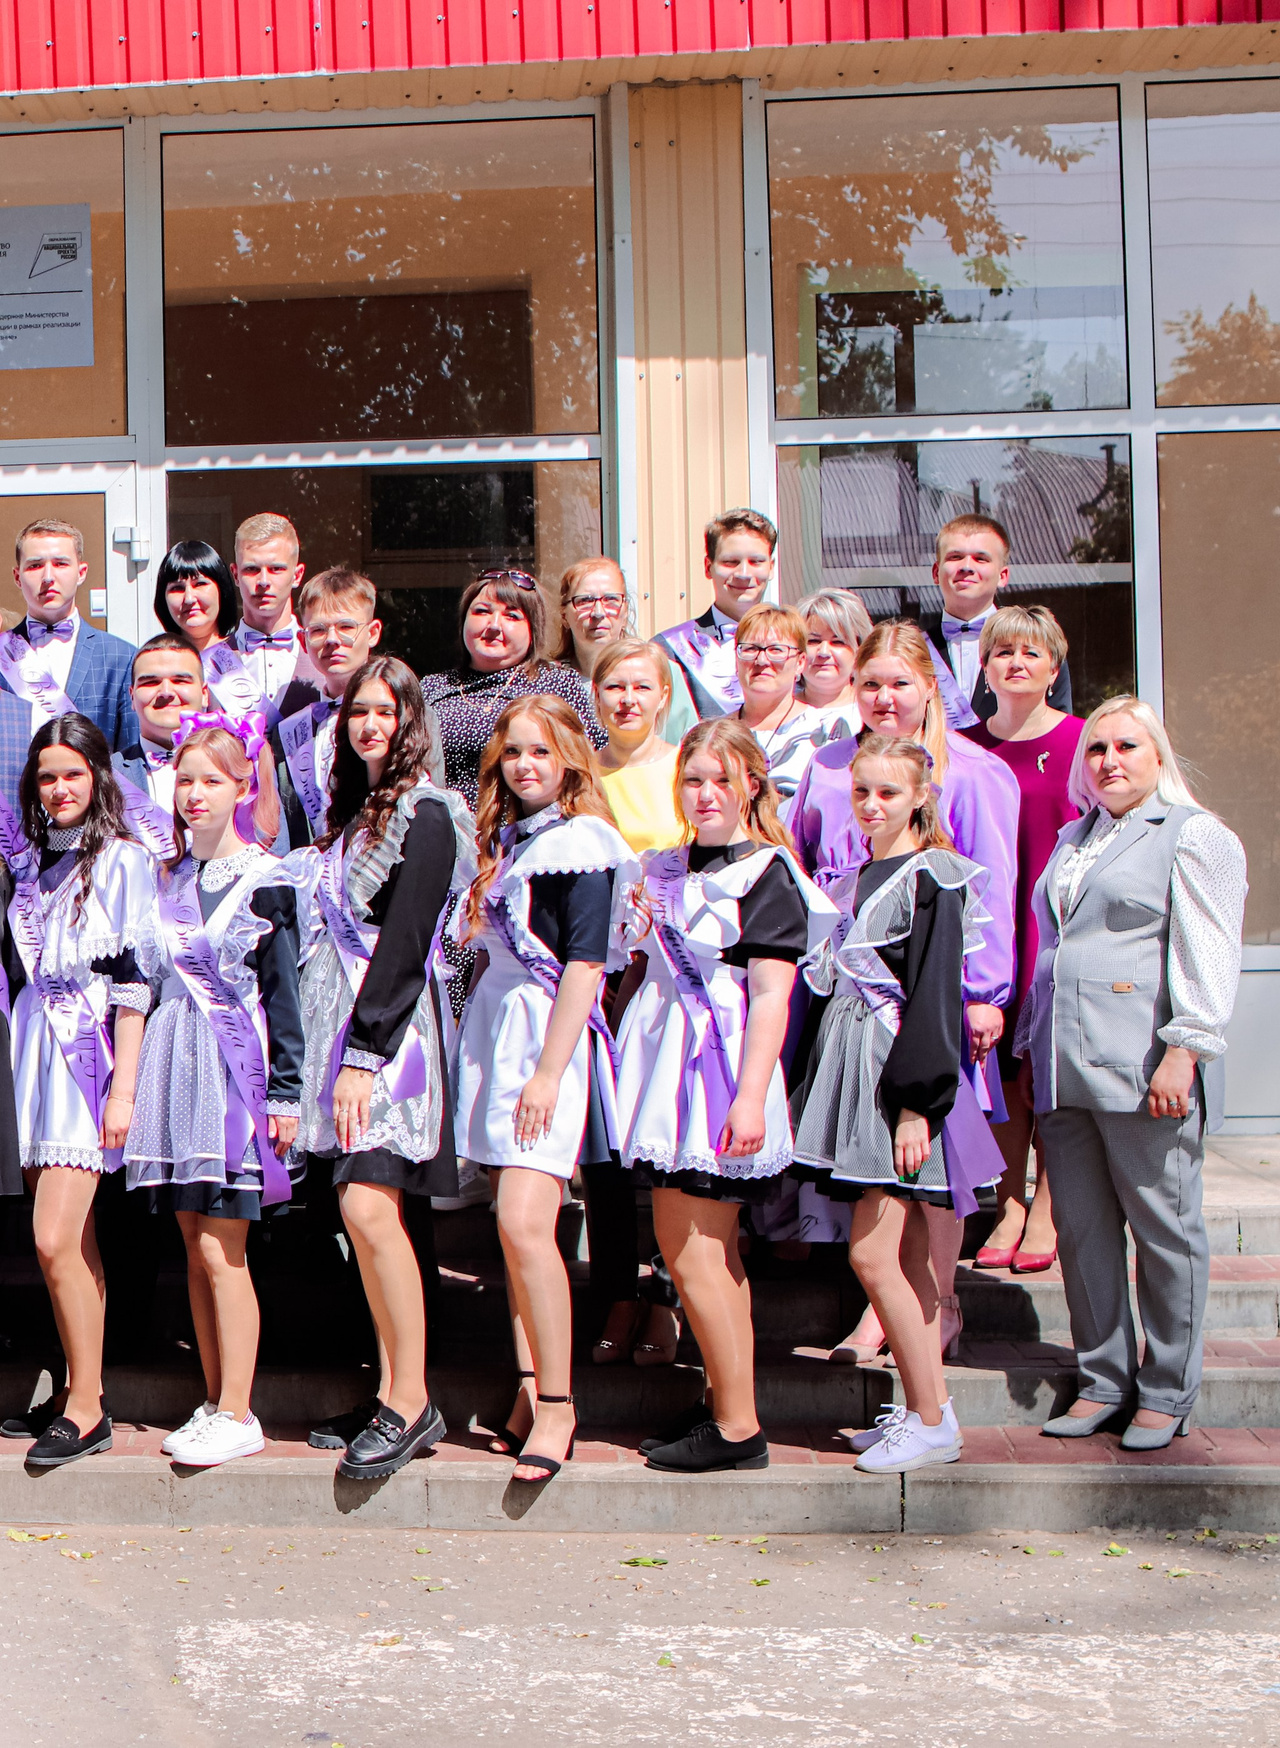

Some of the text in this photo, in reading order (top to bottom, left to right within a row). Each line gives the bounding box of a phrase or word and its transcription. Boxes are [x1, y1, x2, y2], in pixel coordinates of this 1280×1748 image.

[25, 311, 69, 319] Министерства
[18, 323, 41, 331] рамках
[42, 321, 81, 330] реализации
[240, 1057, 267, 1116] 2023
